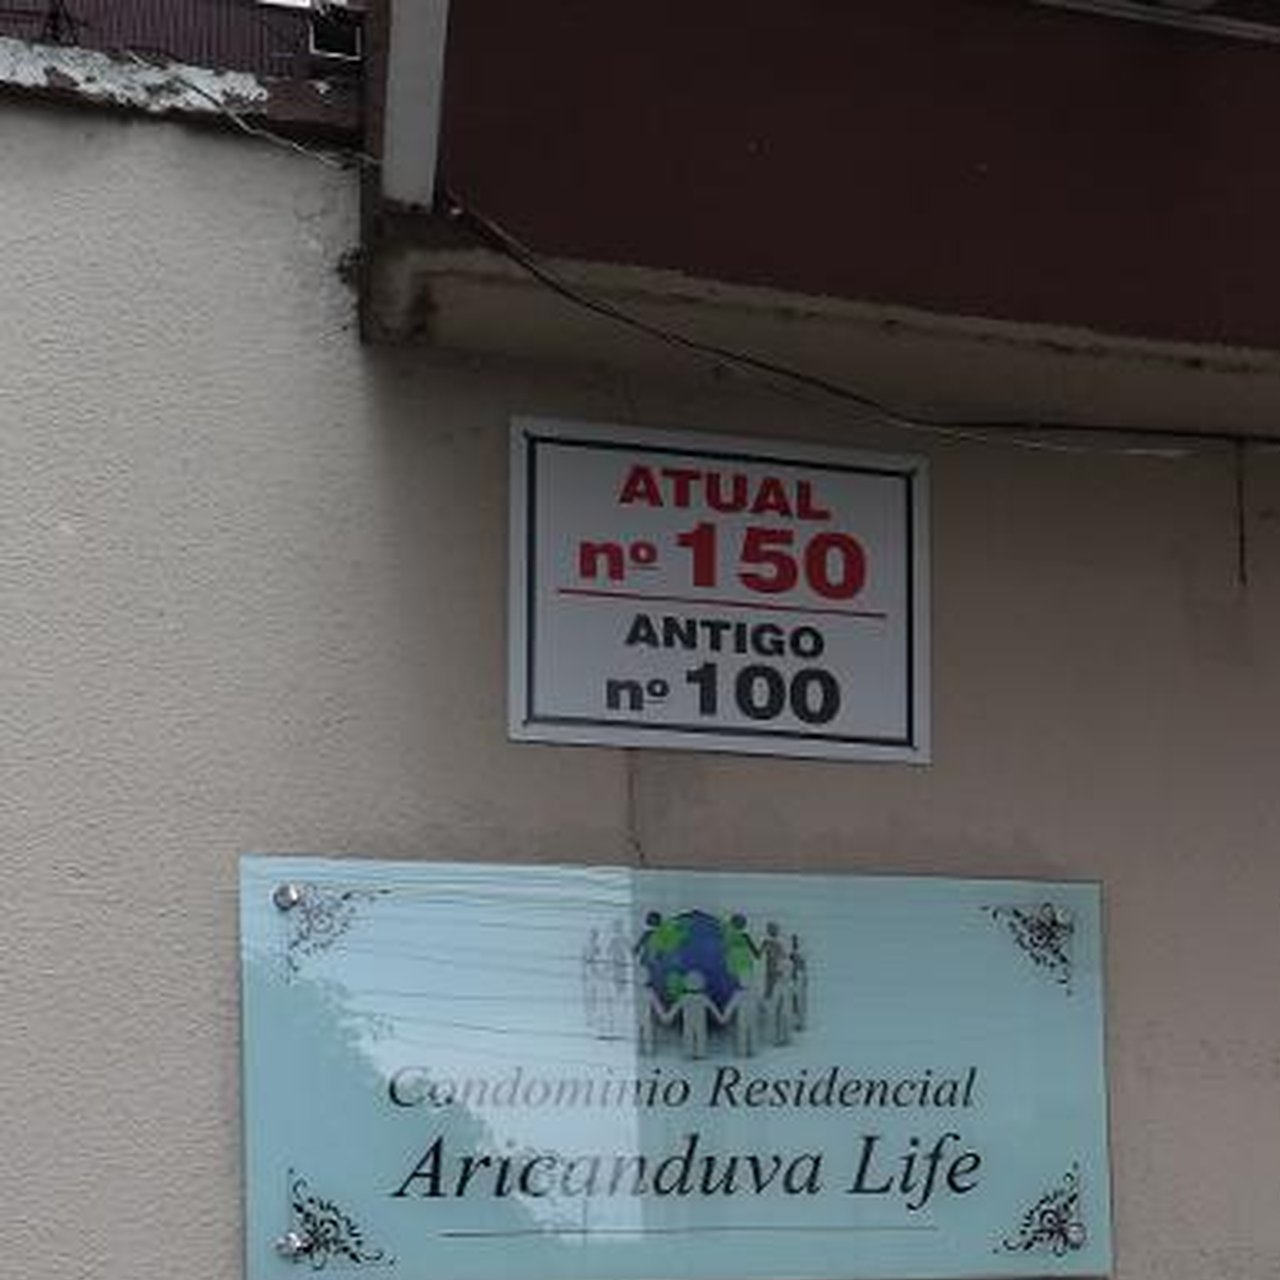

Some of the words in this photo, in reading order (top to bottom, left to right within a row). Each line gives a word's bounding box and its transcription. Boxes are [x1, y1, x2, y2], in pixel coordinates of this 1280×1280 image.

[619, 464, 832, 521] ATUAL
[677, 522, 866, 601] 150
[625, 614, 824, 659] ANTIGO
[686, 662, 841, 725] 100
[708, 1066, 977, 1107] Residencial
[389, 1133, 826, 1198] Aricanduva
[847, 1132, 982, 1211] Life
